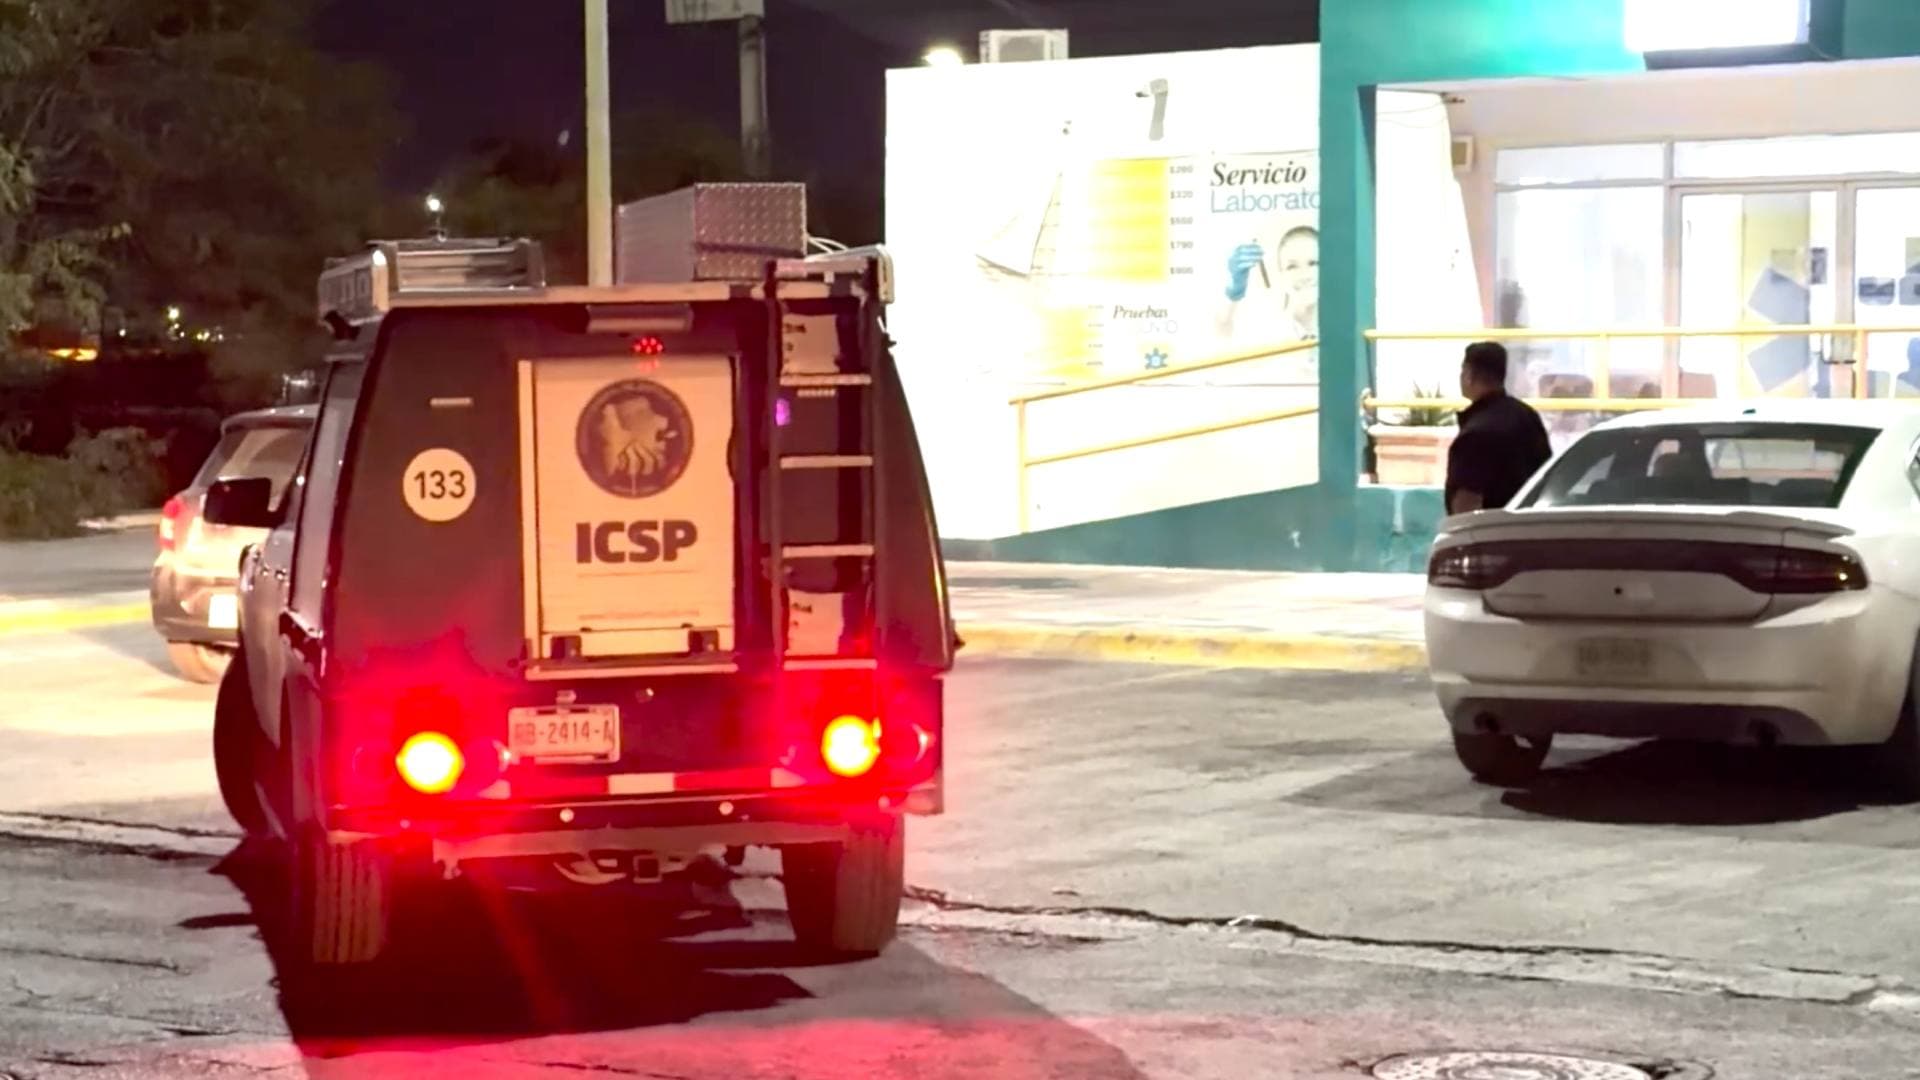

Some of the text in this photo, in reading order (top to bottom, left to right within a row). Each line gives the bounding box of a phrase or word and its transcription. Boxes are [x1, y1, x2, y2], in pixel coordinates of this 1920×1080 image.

[1211, 161, 1307, 187] Servicio
[1112, 304, 1168, 319] Pruebas
[414, 470, 466, 499] 133
[576, 519, 698, 564] ICSP
